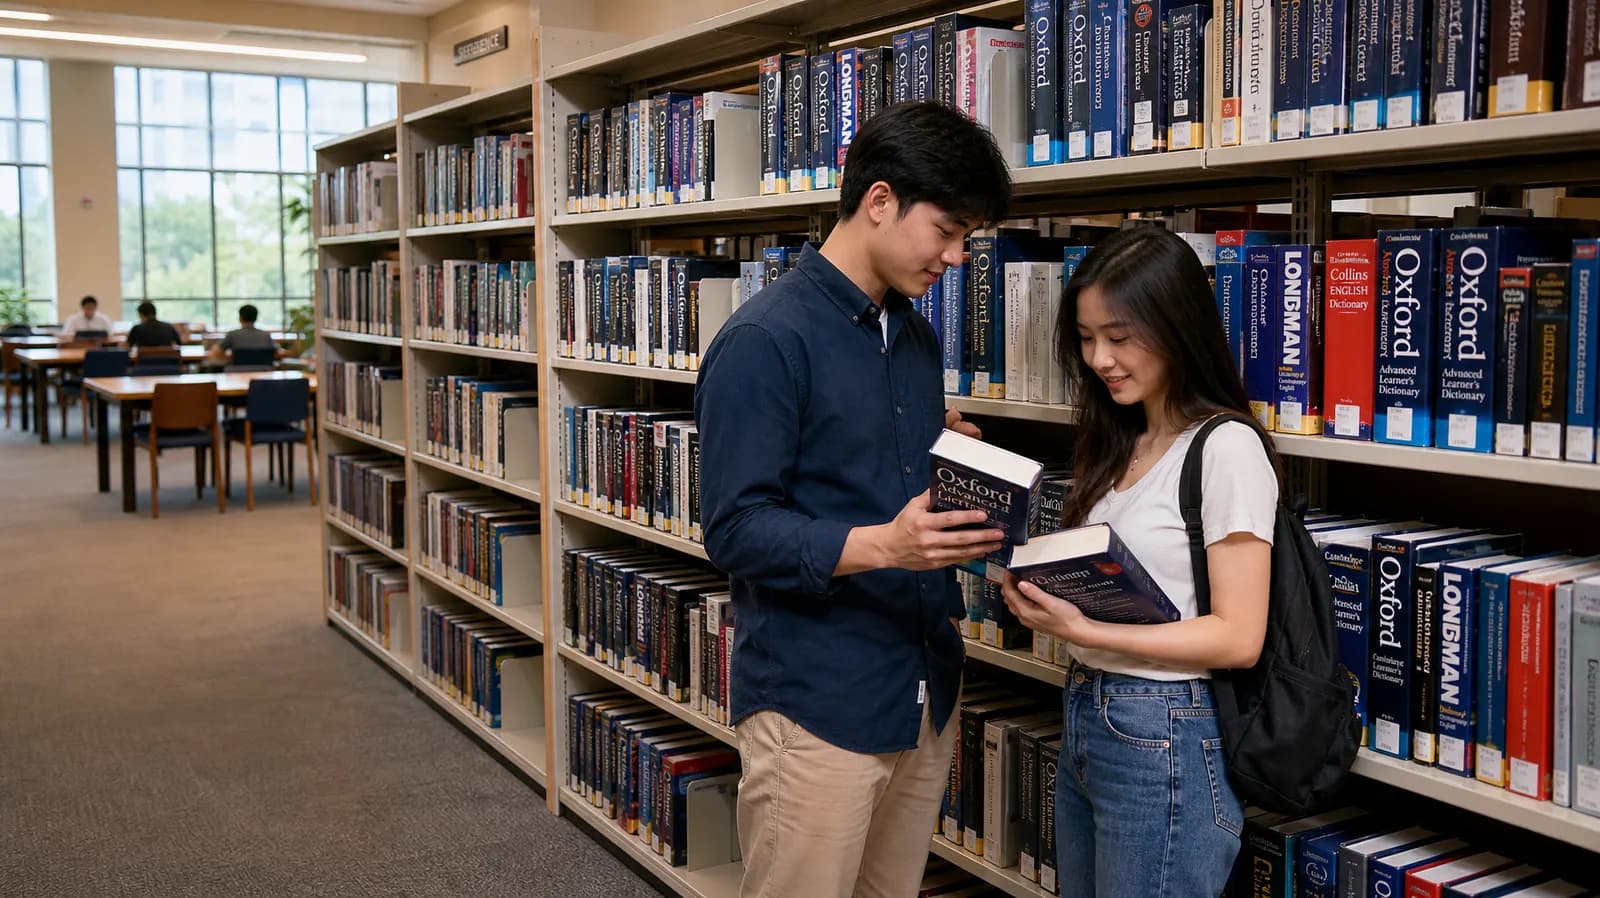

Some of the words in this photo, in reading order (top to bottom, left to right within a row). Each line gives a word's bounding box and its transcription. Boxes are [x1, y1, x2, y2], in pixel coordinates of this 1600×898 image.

[1036, 16, 1050, 87] Oxford
[1073, 14, 1087, 84] Oxford
[767, 77, 777, 138] Oxford
[792, 74, 803, 138] Oxford
[819, 71, 829, 135] Oxford
[841, 53, 852, 145] LONGMAN
[1329, 298, 1369, 311] Dictionary
[1330, 267, 1368, 281] Collins
[1330, 285, 1368, 296] ENGLISH
[1393, 248, 1421, 359] Oxford
[1458, 246, 1488, 361] Oxford
[1283, 251, 1302, 365] LONGMAN
[1379, 364, 1417, 375] Advanced
[1379, 374, 1414, 385] Learner's
[1379, 384, 1420, 399] Dictionary
[1442, 378, 1480, 389] Learner's
[1442, 388, 1486, 403] Dictionary
[936, 467, 1012, 506] Oxford
[1379, 556, 1402, 648] Oxford
[1440, 572, 1462, 705] LONGMAN
